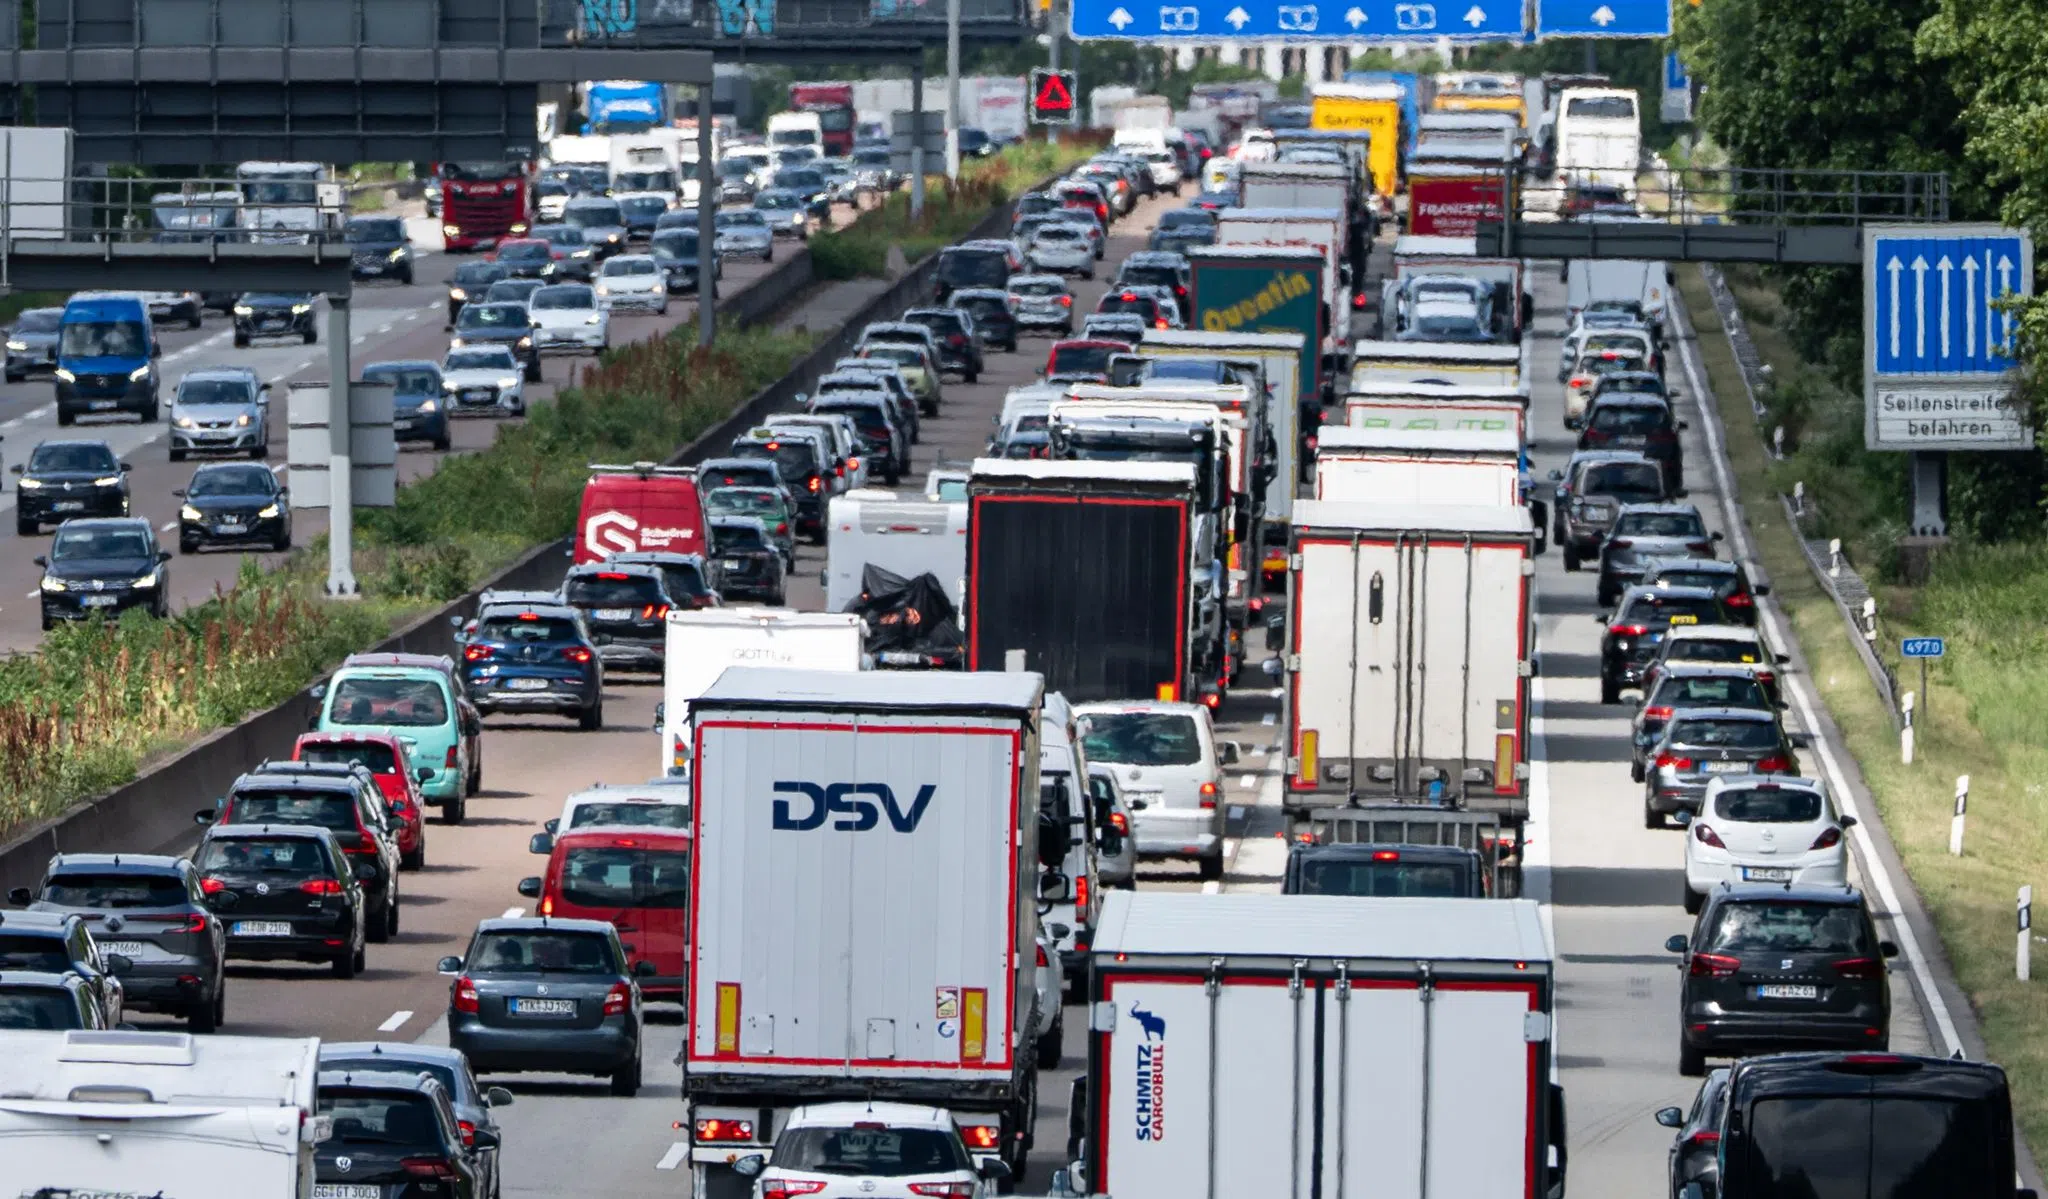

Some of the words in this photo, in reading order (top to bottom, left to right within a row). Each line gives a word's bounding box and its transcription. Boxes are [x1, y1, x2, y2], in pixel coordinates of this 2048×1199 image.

[1884, 393, 2010, 412] Seitenstreife
[1909, 419, 1992, 436] befahren
[773, 781, 937, 834] DSV
[1136, 1044, 1151, 1141] SCHMITZ
[1152, 1044, 1164, 1141] CARGOBULL
